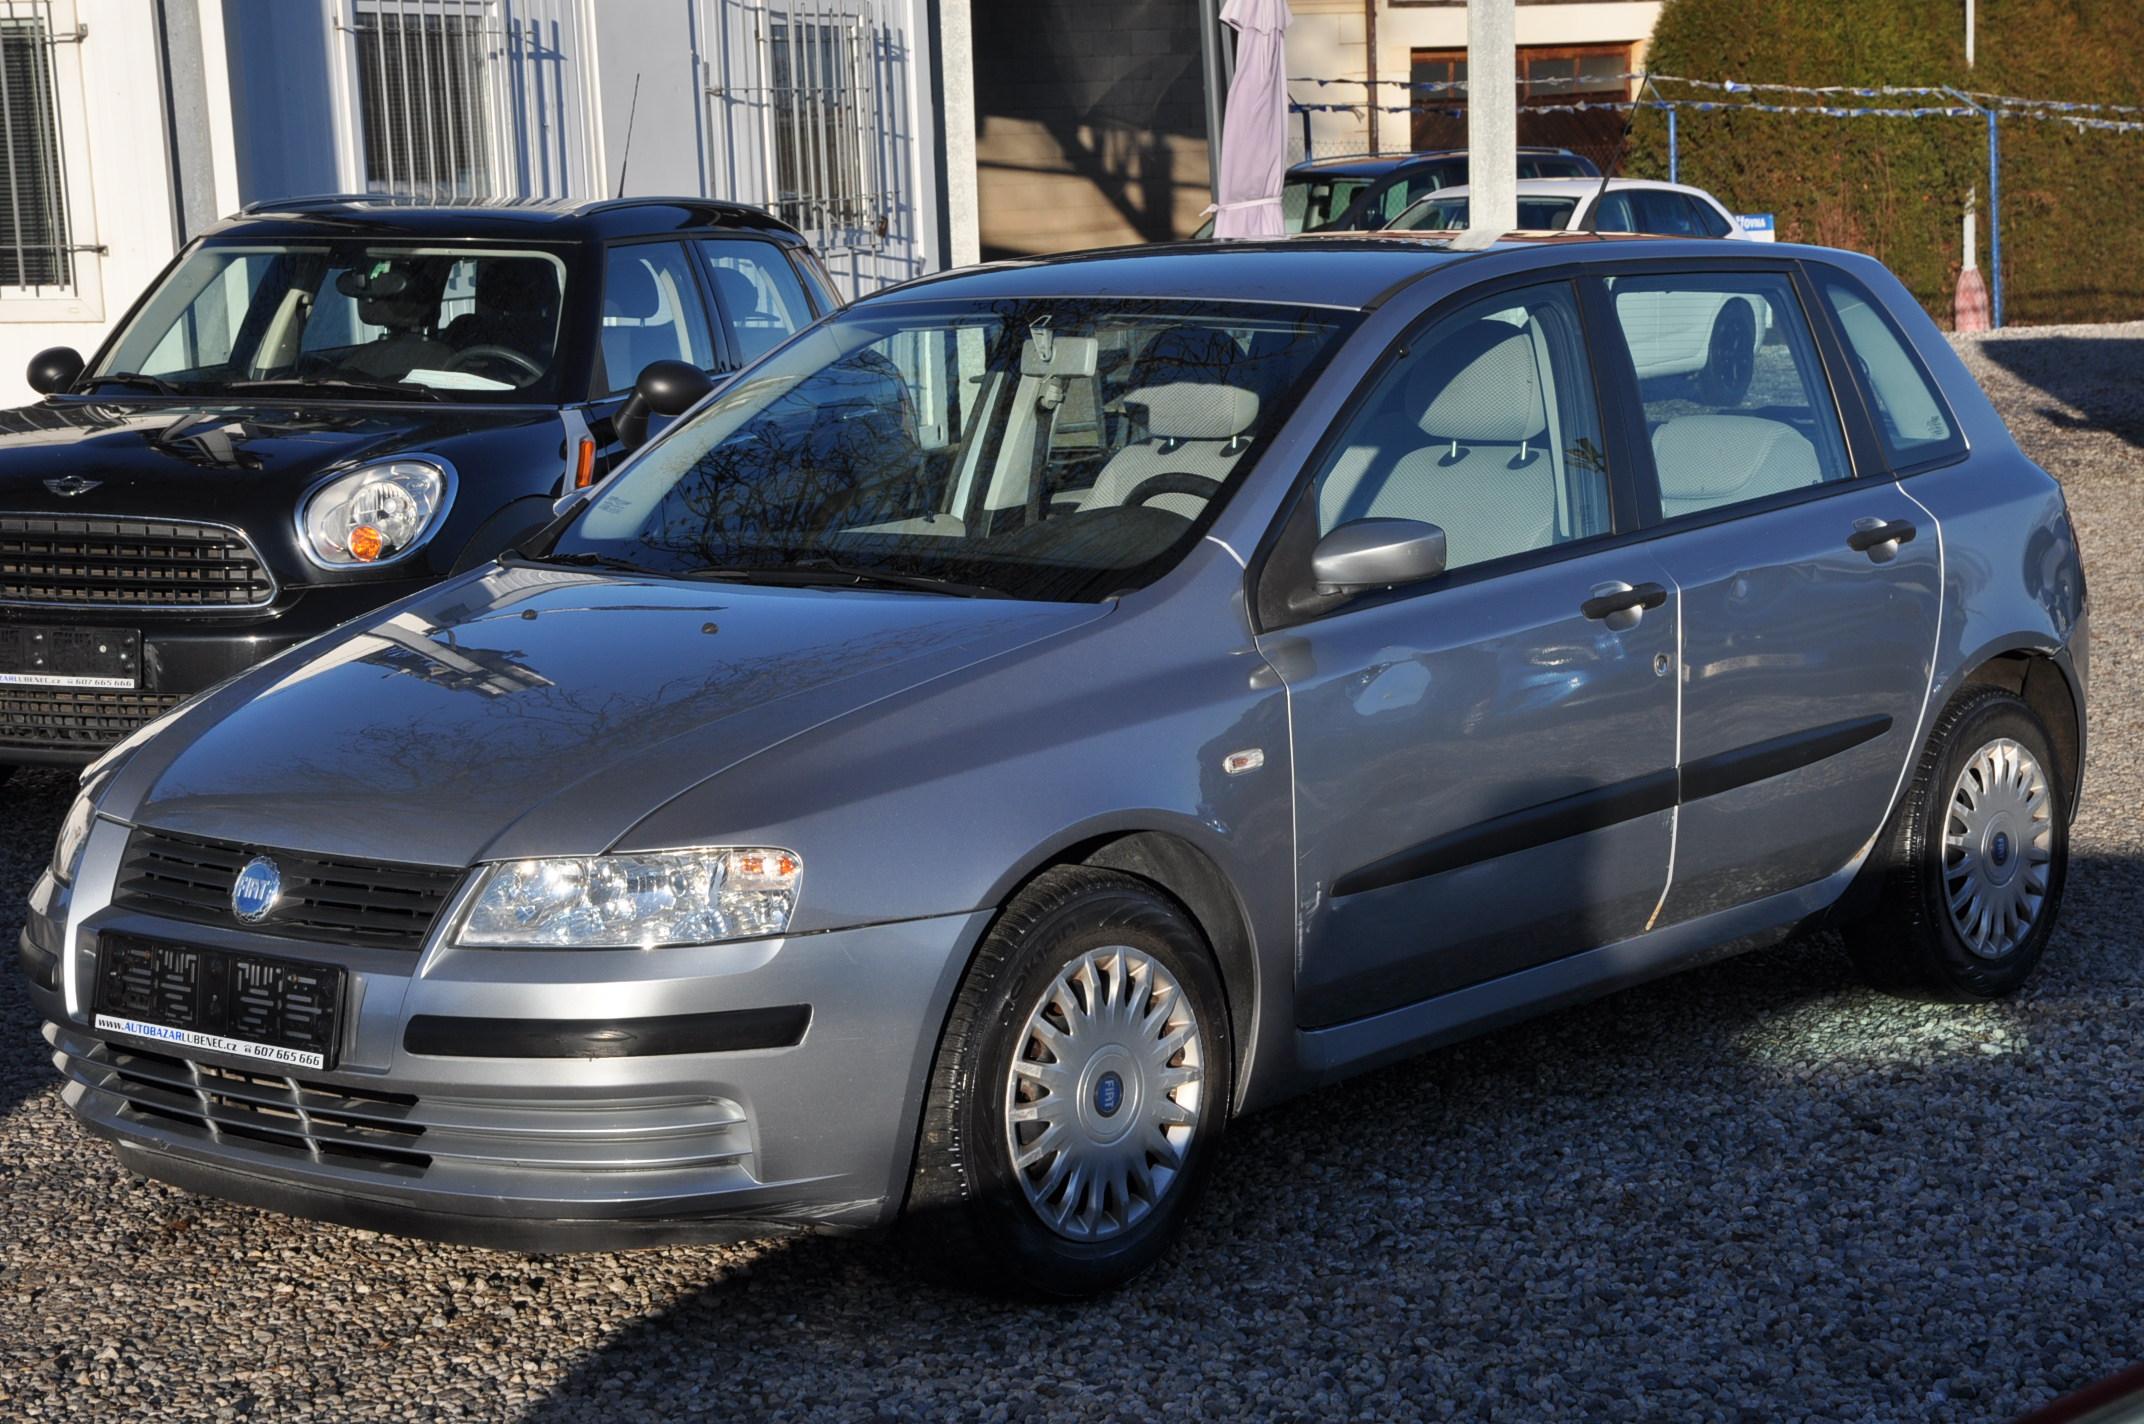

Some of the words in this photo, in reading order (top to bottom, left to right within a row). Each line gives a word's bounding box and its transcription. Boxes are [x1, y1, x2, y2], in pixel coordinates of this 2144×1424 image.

[238, 876, 271, 900] FIAT
[254, 1045, 274, 1057] 607
[276, 1049, 297, 1062] 665
[298, 1053, 320, 1066] 666
[1104, 1079, 1115, 1107] FIAT
